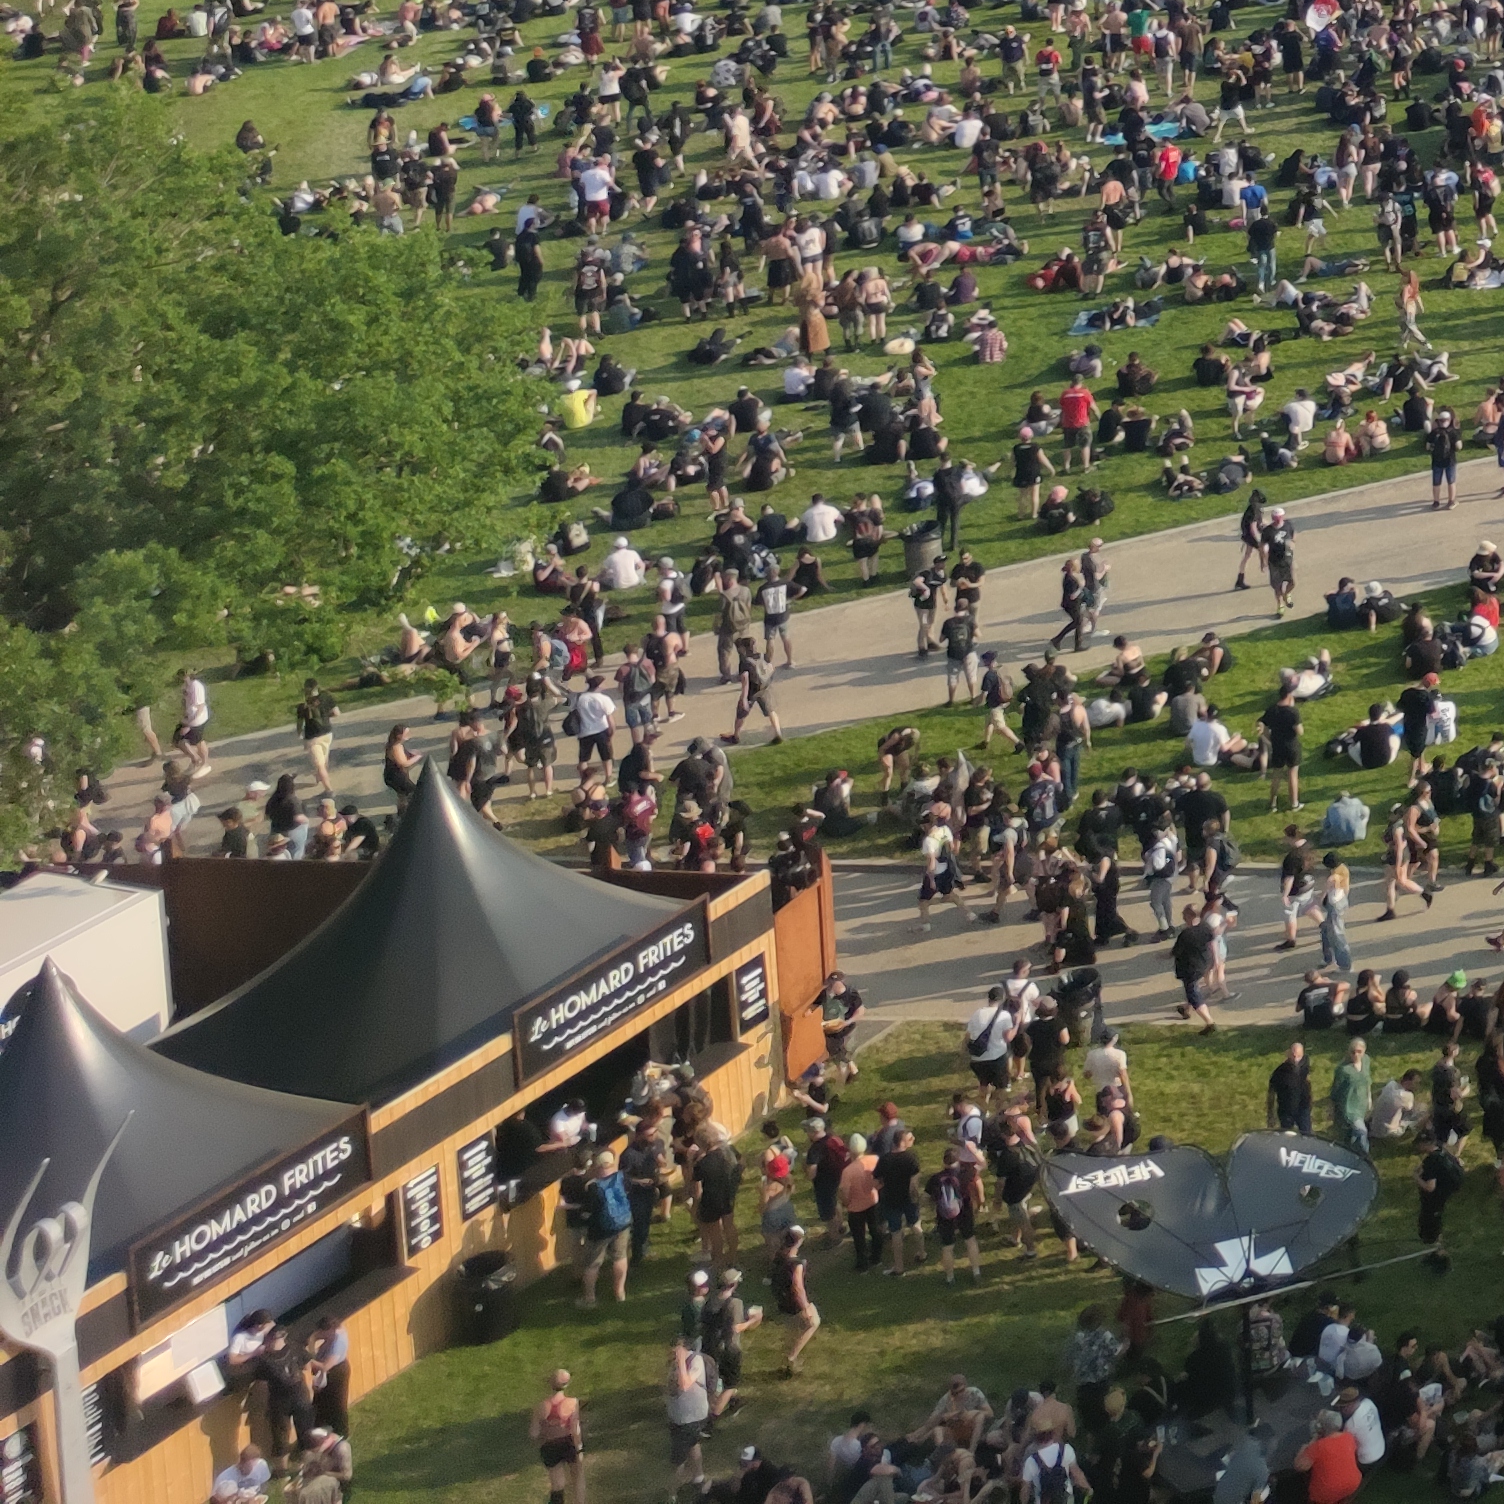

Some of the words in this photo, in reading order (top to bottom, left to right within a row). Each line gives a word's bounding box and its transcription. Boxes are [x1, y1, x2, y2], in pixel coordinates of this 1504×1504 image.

[550, 961, 635, 1030] HOMARD
[637, 922, 695, 974] FRITES
[173, 1184, 277, 1264] HOMARD
[282, 1136, 353, 1196] FRITES
[1058, 1159, 1165, 1196] HELLFEST
[1280, 1147, 1361, 1182] HELLFEST
